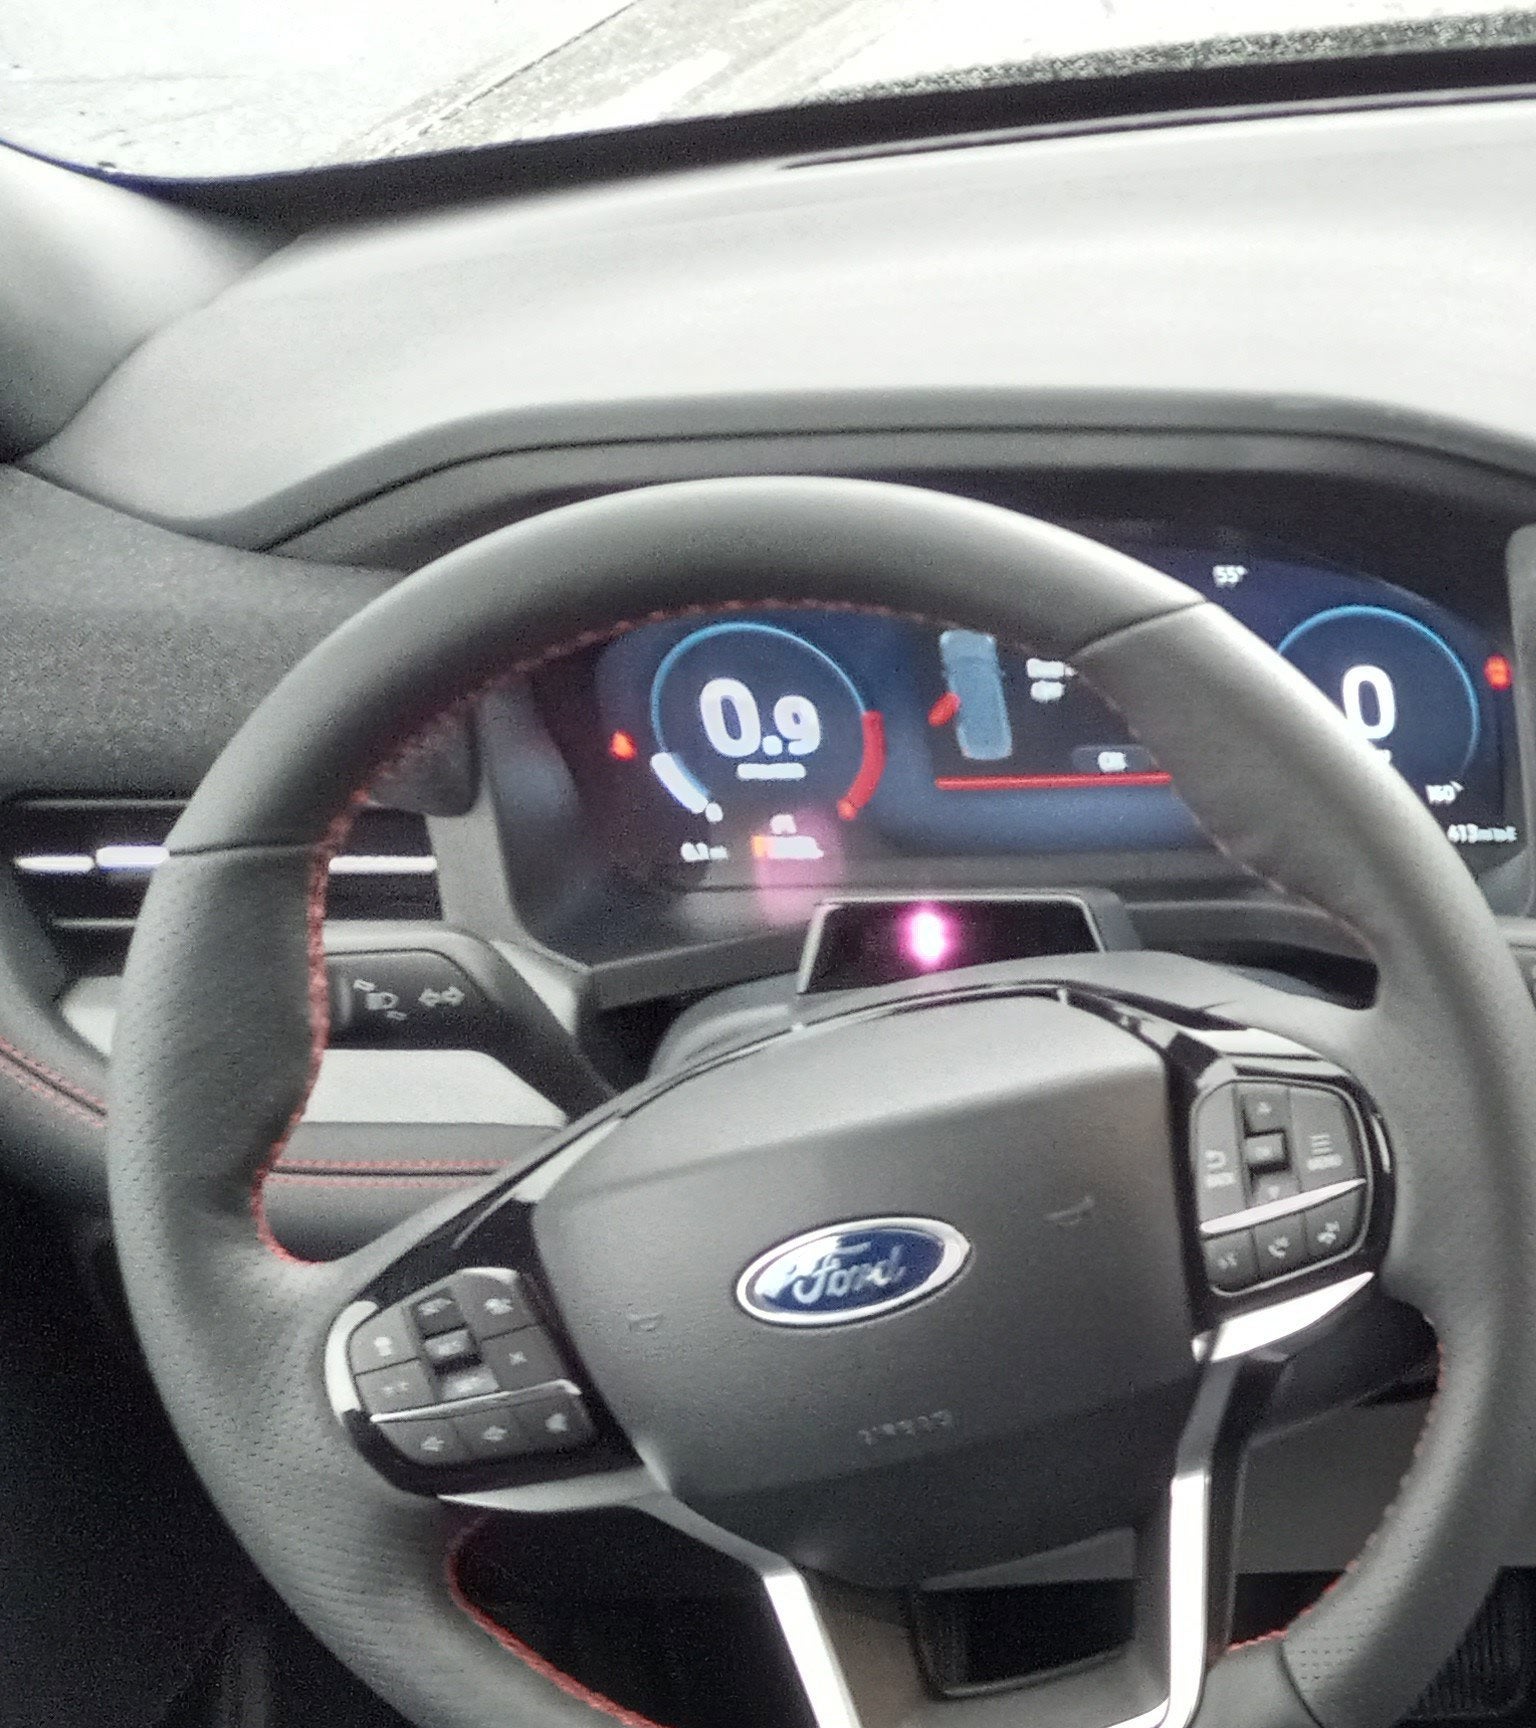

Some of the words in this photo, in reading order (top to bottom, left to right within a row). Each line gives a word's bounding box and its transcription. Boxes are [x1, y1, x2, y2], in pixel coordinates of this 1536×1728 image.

[700, 678, 821, 758] 0.9
[1342, 665, 1396, 741] 0
[788, 1241, 906, 1304] Ford
